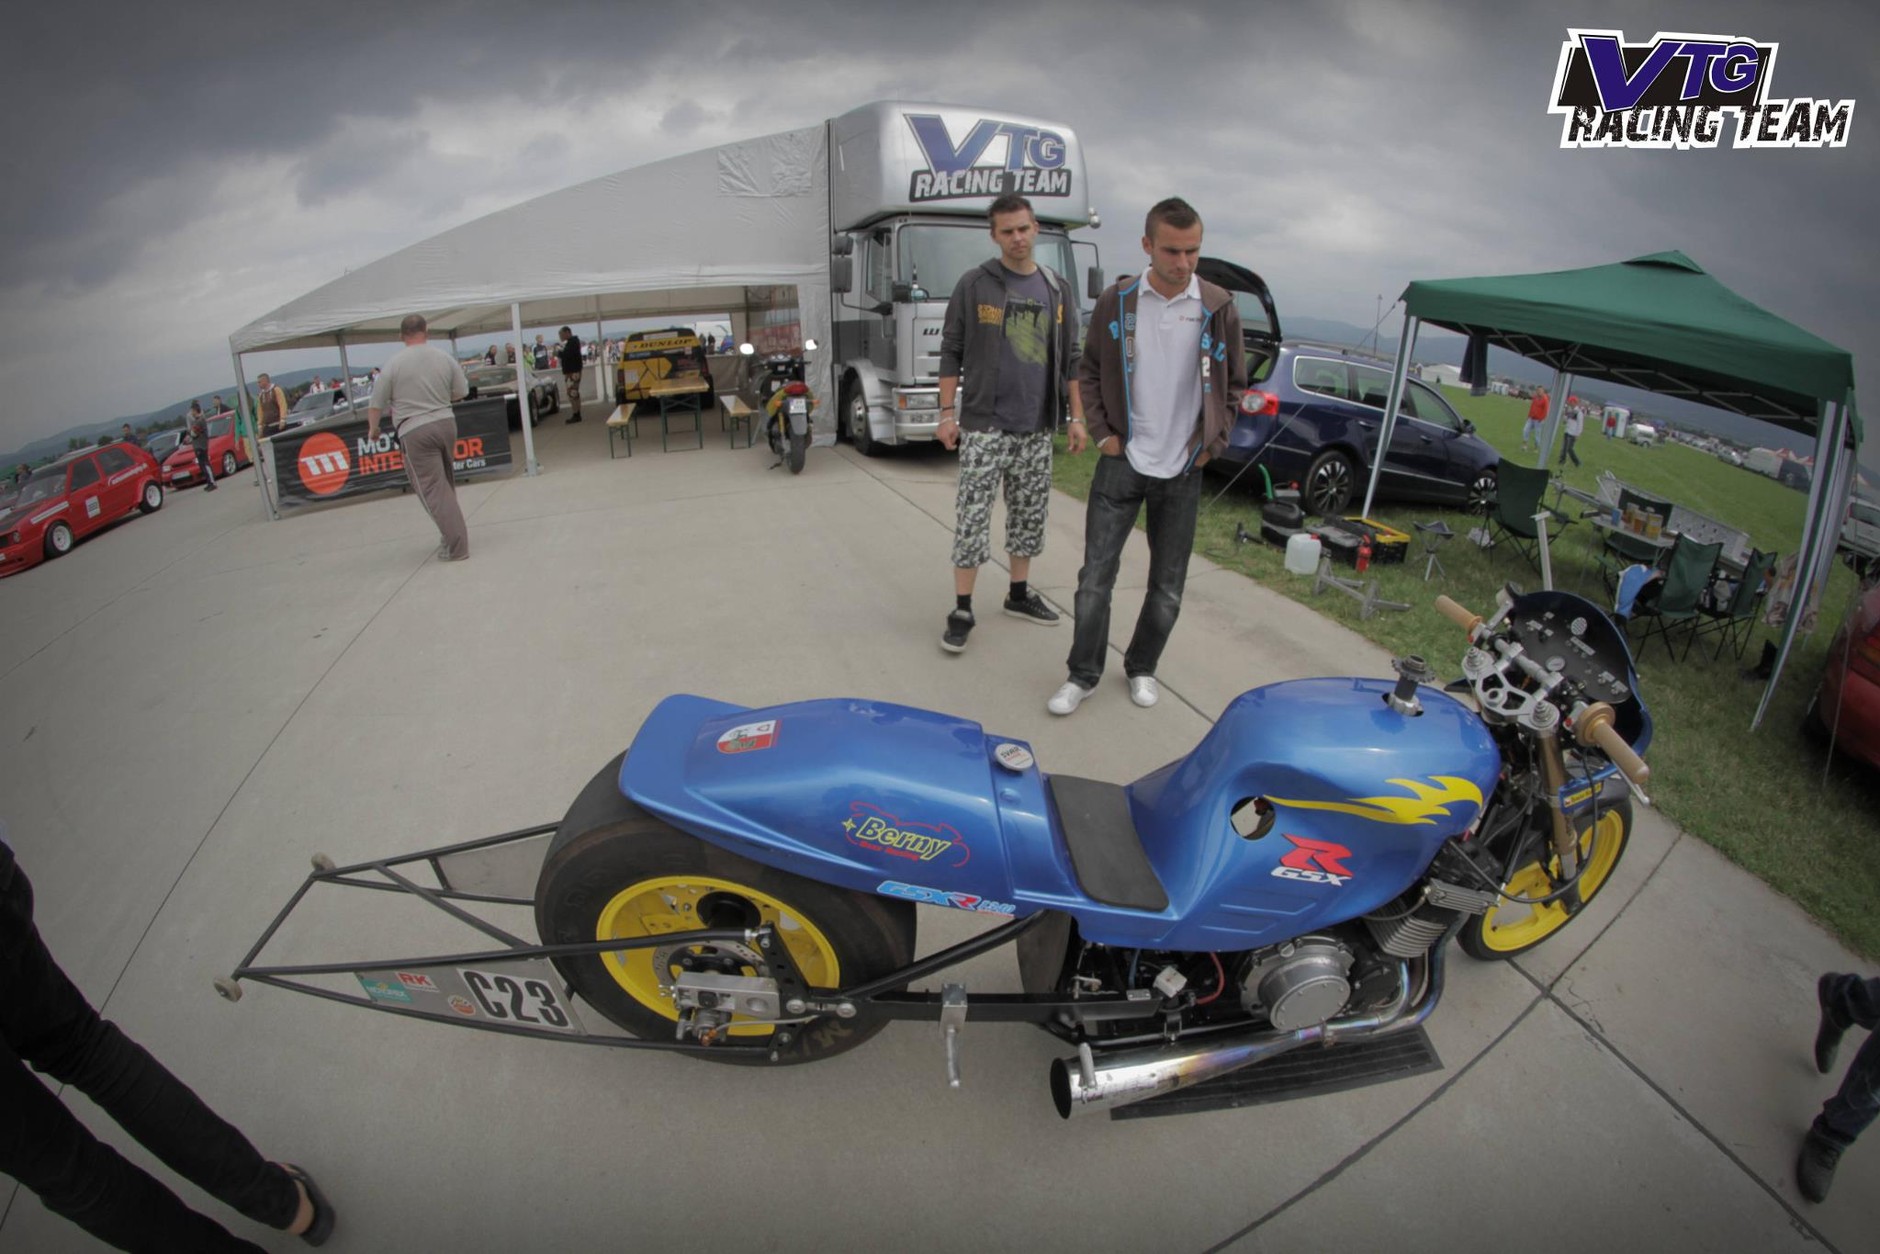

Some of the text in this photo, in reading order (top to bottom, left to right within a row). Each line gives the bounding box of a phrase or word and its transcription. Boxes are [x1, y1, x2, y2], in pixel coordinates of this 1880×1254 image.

[903, 114, 1066, 178] VTG
[914, 168, 1068, 199] RACING TEAM
[640, 338, 691, 348] DUNLOP
[855, 816, 952, 861] Berny
[1280, 833, 1353, 876] R
[1271, 866, 1352, 887] GSX
[399, 972, 433, 986] RK
[463, 971, 569, 1028] C23
